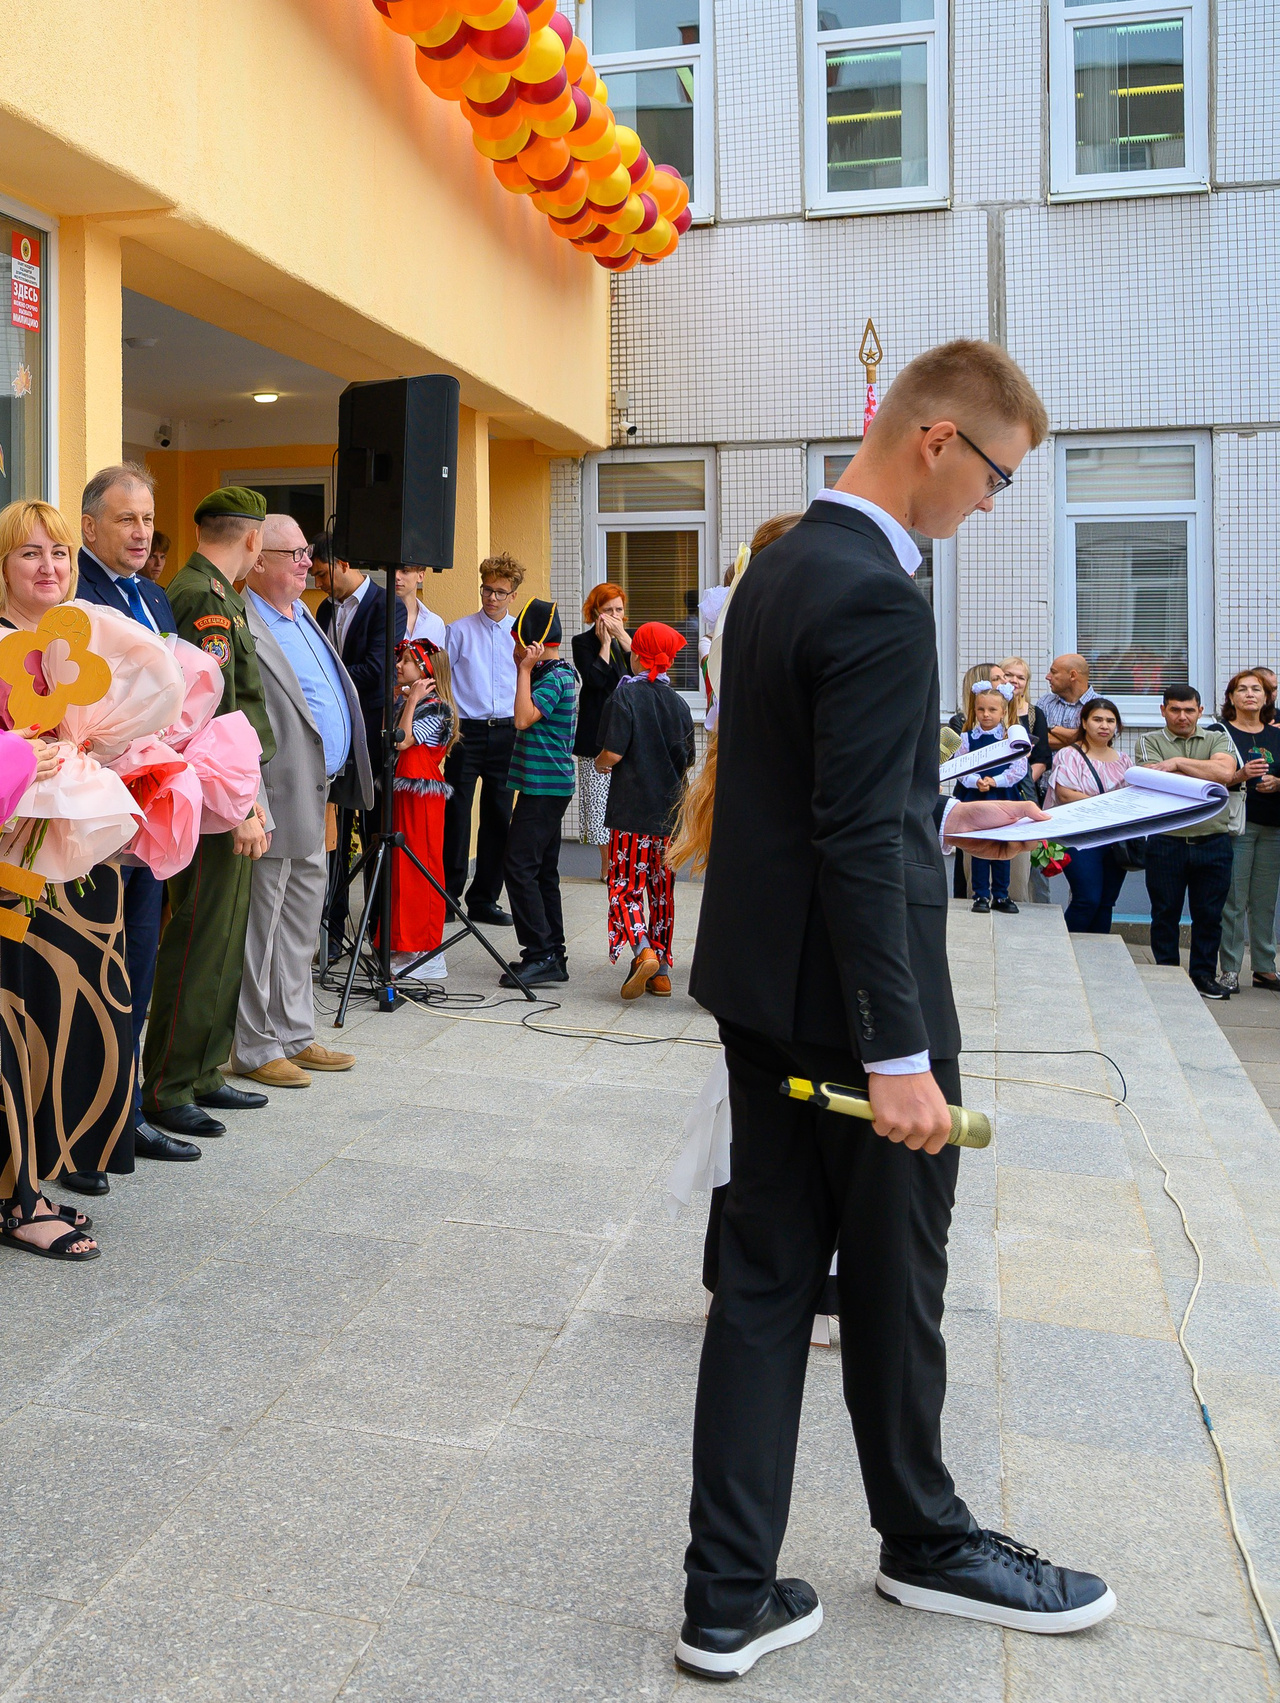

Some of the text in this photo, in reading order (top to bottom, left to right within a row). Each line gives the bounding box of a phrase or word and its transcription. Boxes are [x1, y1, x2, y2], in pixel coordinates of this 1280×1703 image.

[13, 281, 39, 303] ЗДЕСЬ
[12, 312, 39, 329] МИЛИЦИЮ
[199, 617, 228, 627] СПЕЦНАЗ
